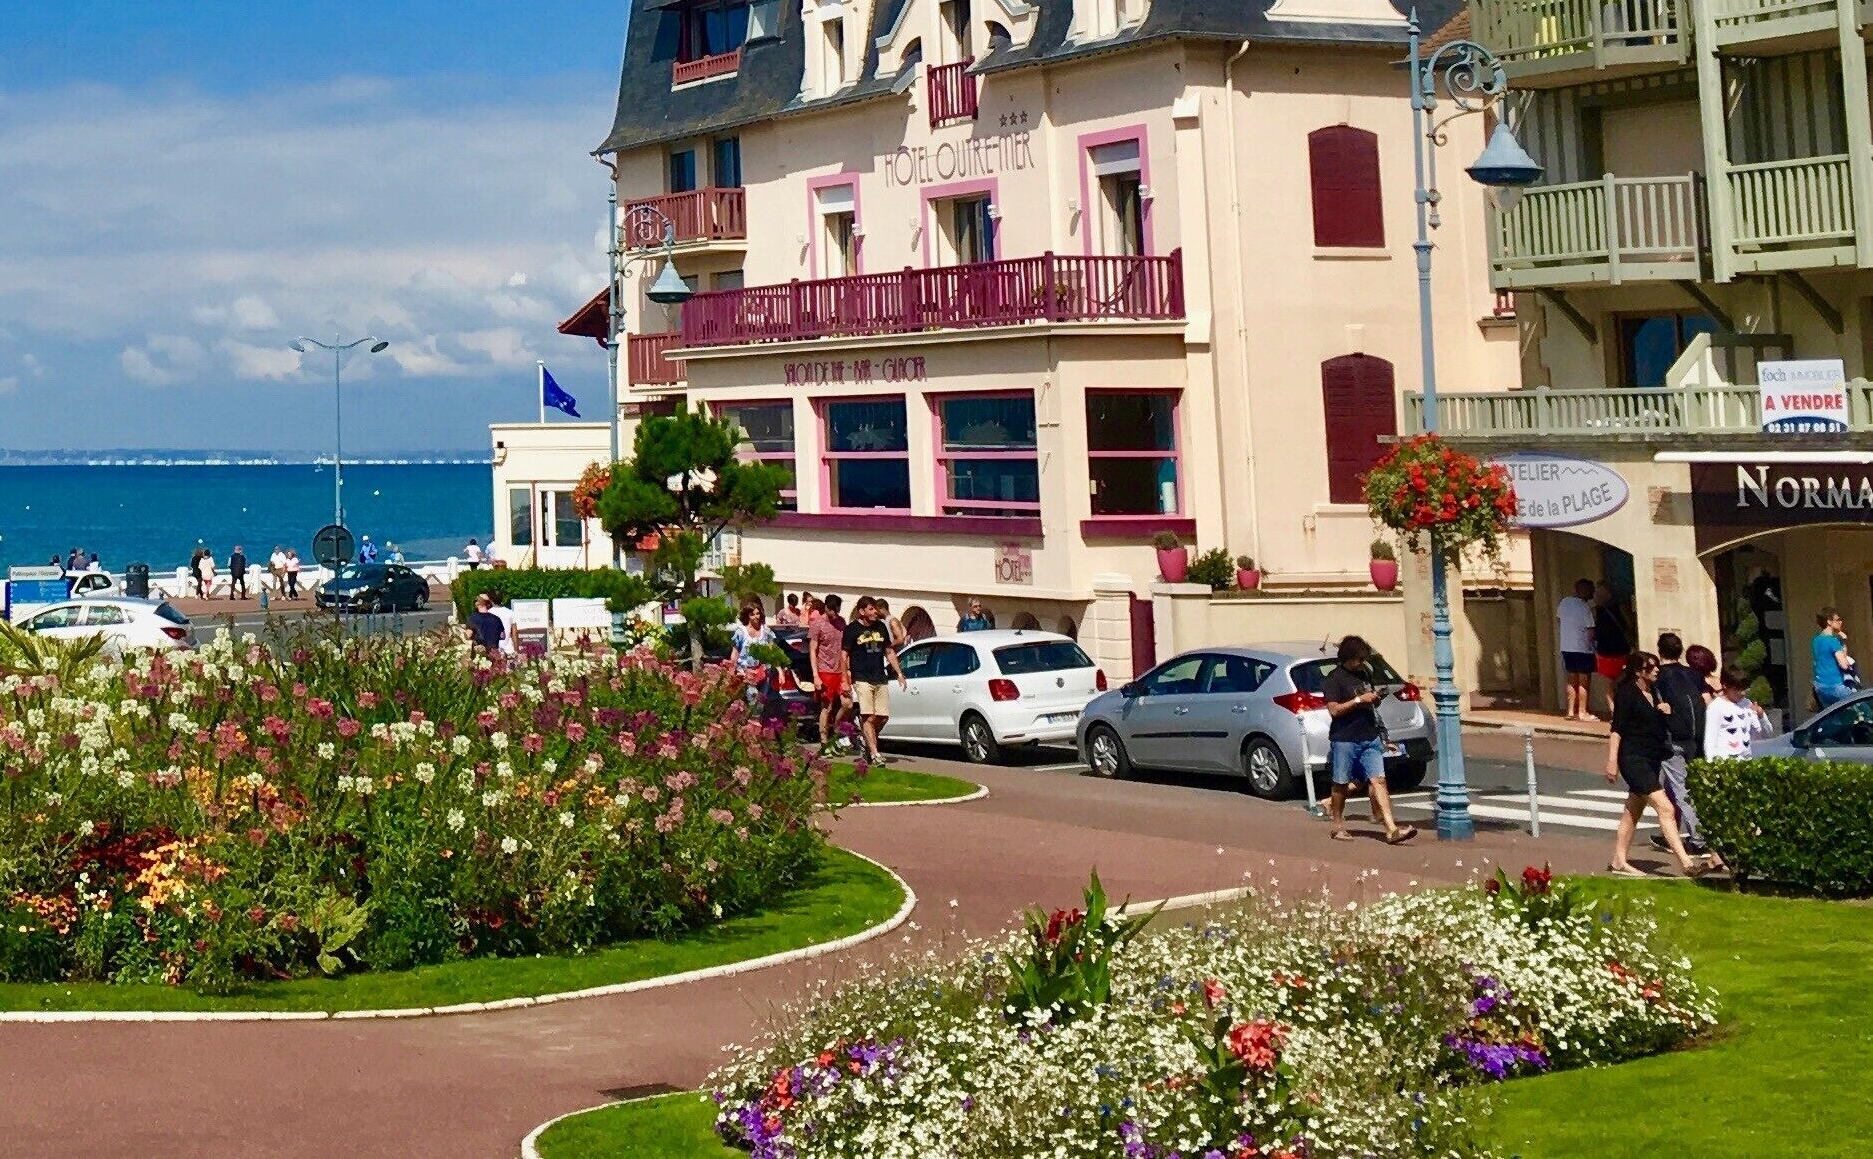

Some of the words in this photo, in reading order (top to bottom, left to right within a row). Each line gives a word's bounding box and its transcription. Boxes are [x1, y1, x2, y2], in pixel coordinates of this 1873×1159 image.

[884, 145, 933, 188] HÔTEL
[1765, 394, 1777, 411] A
[1780, 393, 1844, 411] VENDRE
[1767, 422, 1782, 433] 02
[1783, 422, 1796, 433] 31
[1528, 499, 1545, 518] de
[1547, 499, 1560, 517] la
[1561, 481, 1613, 514] PLAGE
